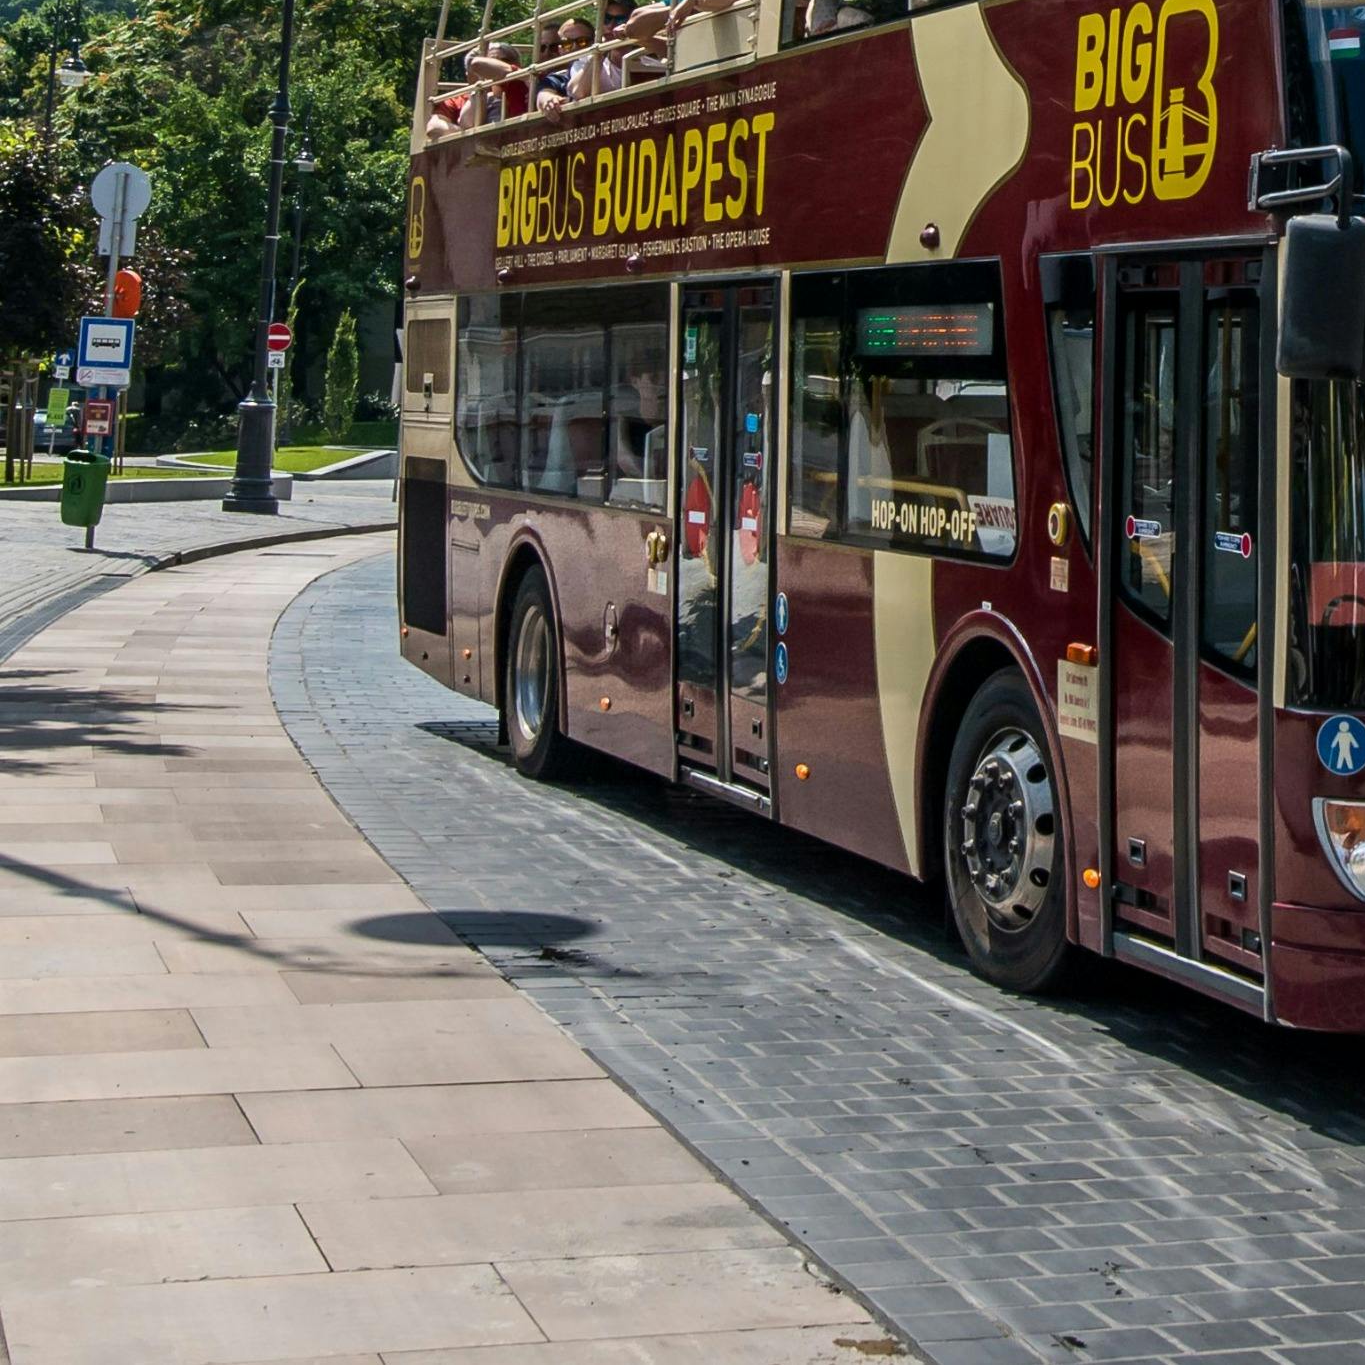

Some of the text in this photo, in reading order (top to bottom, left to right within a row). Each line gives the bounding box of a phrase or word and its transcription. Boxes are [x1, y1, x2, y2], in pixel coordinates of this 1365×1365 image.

[1075, 2, 1153, 112] BIG
[518, 137, 538, 154] DISTRICT
[573, 123, 596, 143] BASILICA
[600, 120, 611, 137] THE
[629, 111, 649, 130] PALACE
[653, 105, 676, 125] HEROES
[677, 98, 702, 119] SQUARE
[706, 94, 719, 113] THE
[719, 91, 737, 110] MAIN
[737, 81, 777, 107] SYNAGOGUE
[593, 112, 775, 236] BUDAPEST
[1071, 113, 1147, 209] BUS
[558, 246, 588, 263] PARLIAMENT
[590, 243, 618, 260] MARGARET
[618, 242, 638, 259] ISLAND
[643, 237, 680, 257] FISHERMAN'S
[681, 235, 708, 253] BASTION
[712, 232, 725, 250] THE
[725, 230, 747, 249] OPERA
[747, 227, 771, 246] HOUSE
[871, 499, 977, 543] HOP-ON HOP-OFF
